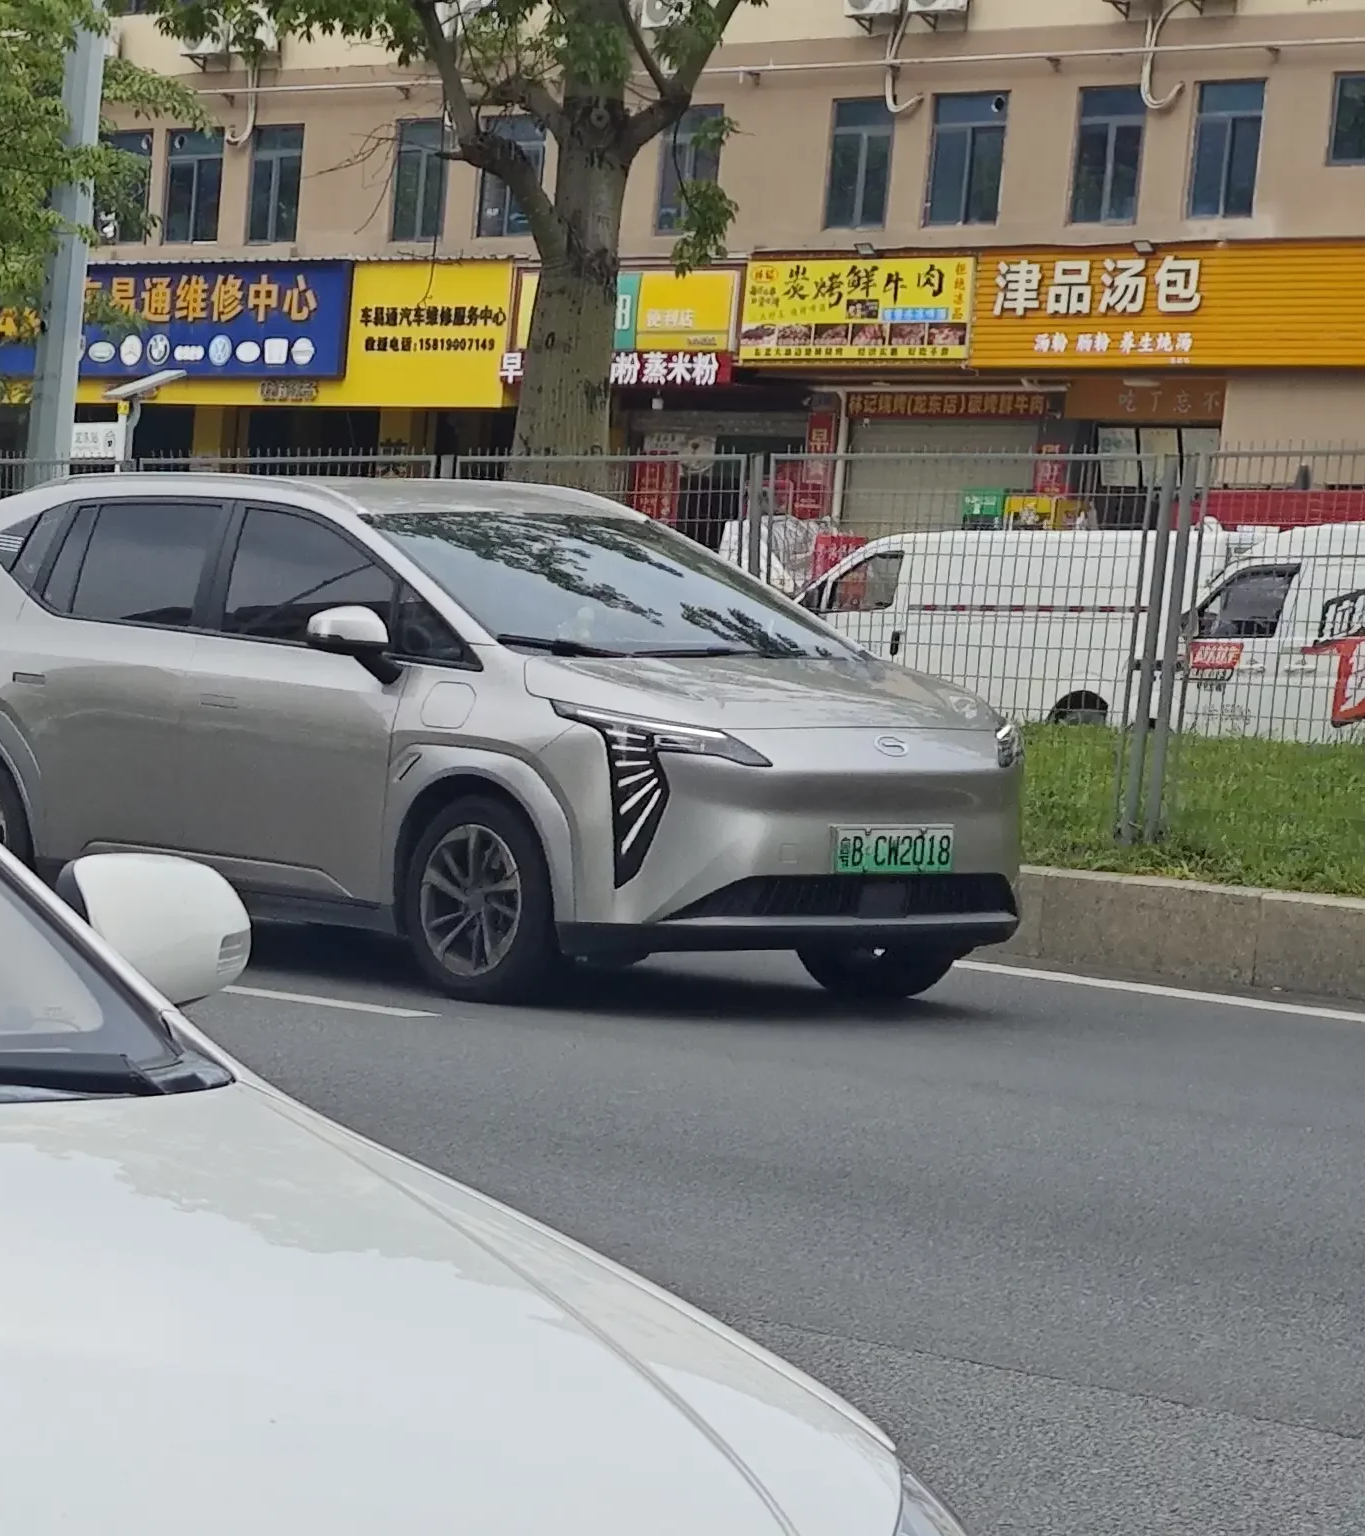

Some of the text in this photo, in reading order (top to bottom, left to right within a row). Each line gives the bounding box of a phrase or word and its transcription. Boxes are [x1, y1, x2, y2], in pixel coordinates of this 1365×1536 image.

[783, 264, 945, 309] 炭烤鲜牛肉
[993, 256, 1201, 316] 津品汤包
[360, 306, 507, 327] 车易通汽车维修服务中心
[499, 352, 524, 384] 早
